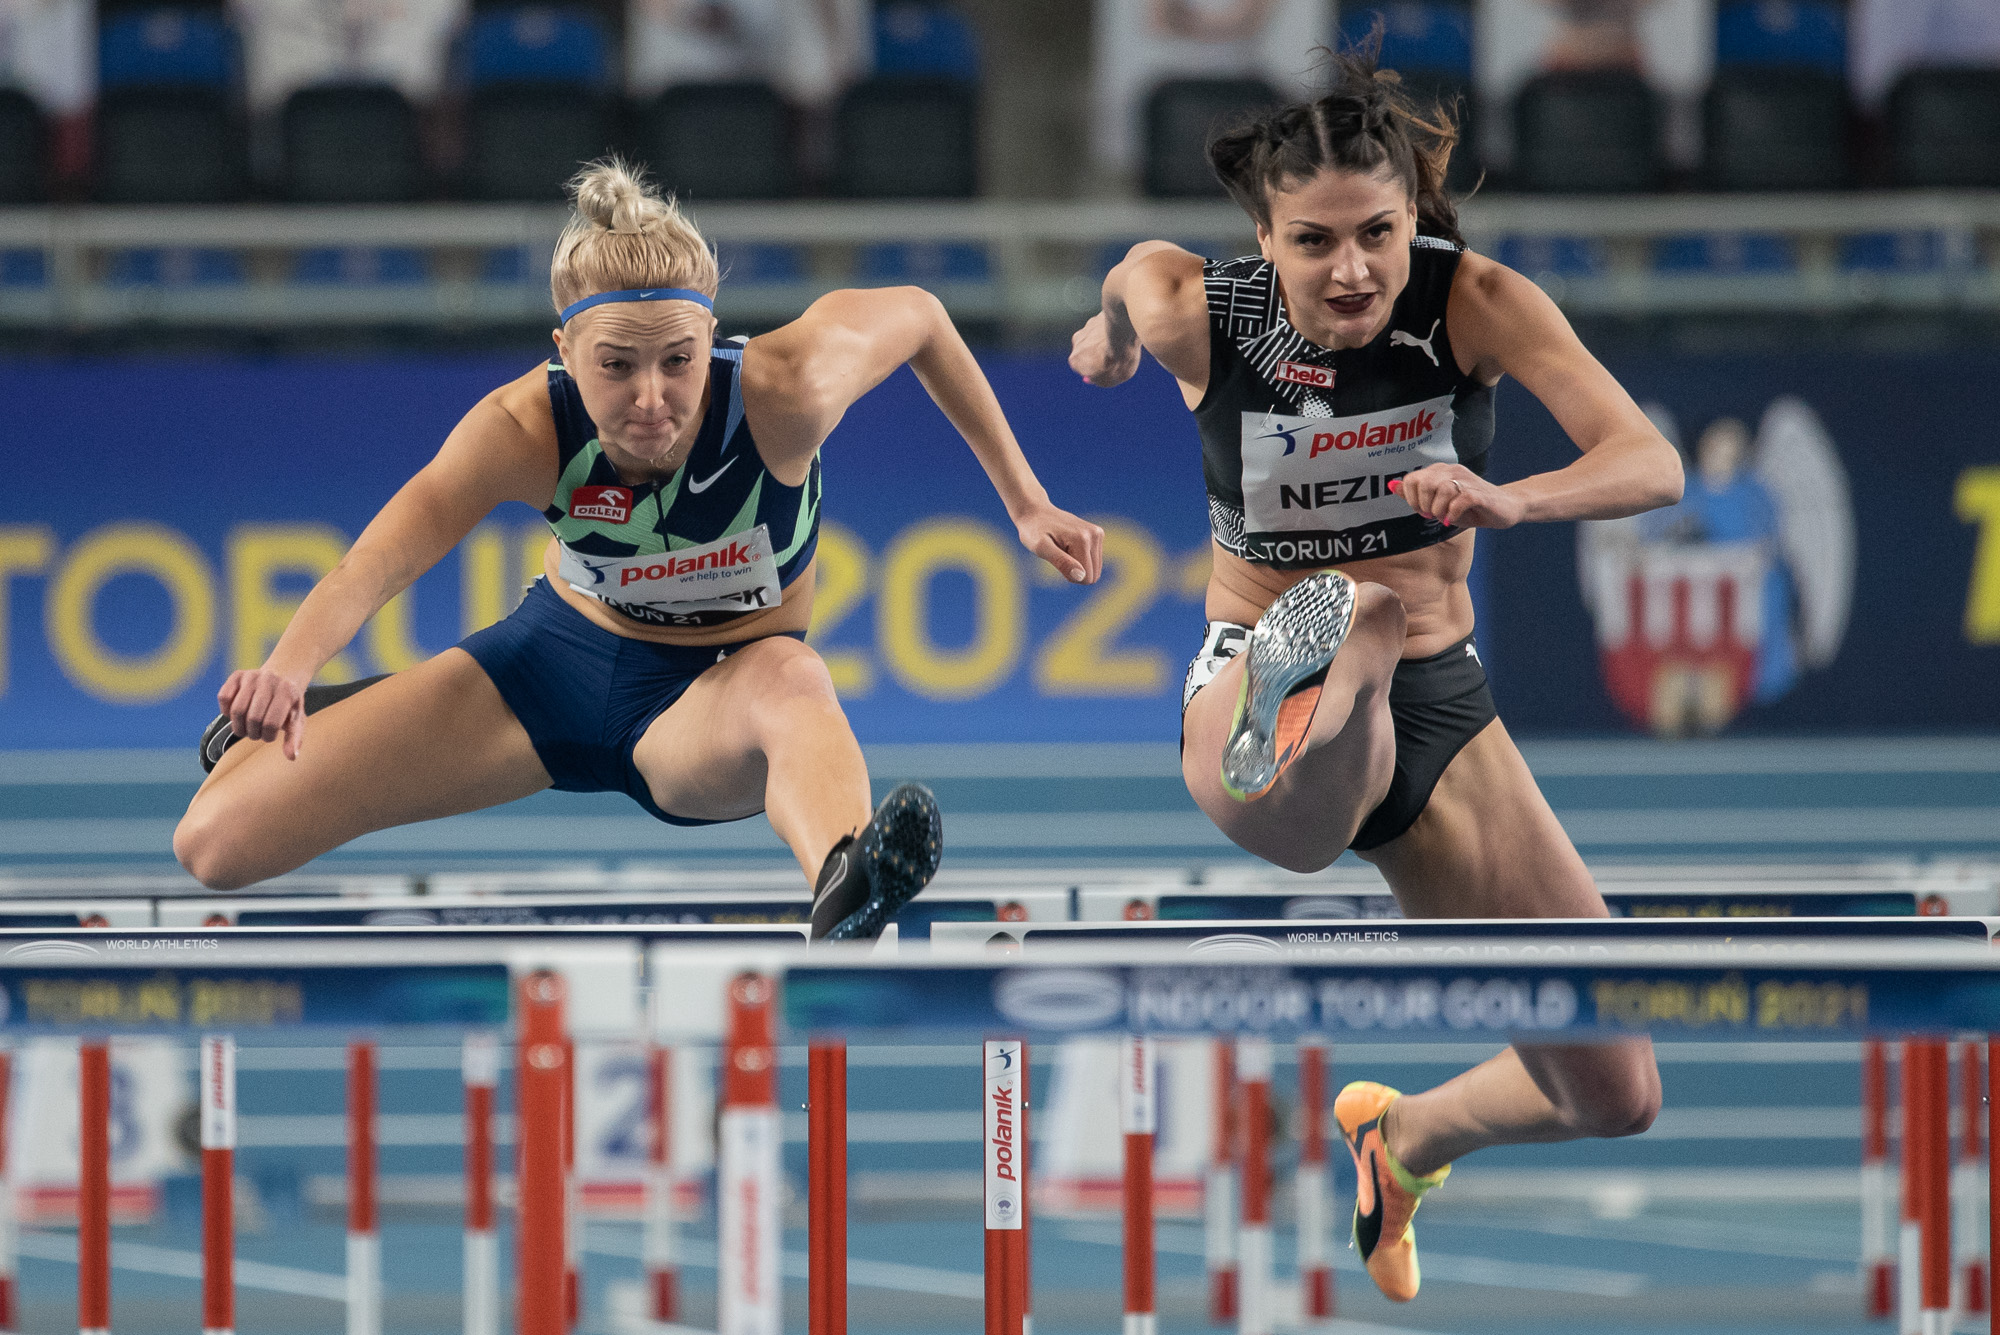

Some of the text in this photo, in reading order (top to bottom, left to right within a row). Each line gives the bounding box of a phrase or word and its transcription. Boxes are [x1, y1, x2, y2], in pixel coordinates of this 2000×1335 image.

[1286, 365, 1327, 384] helo
[1309, 408, 1437, 459] polanik
[1367, 450, 1382, 458] we
[1384, 445, 1405, 455] help
[1408, 443, 1416, 451] to
[578, 507, 622, 517] ORLEN
[1260, 530, 1388, 562] TORUŃ 21
[620, 541, 750, 587] polanik
[680, 566, 752, 583] we help to win
[106, 939, 218, 950] WORLD ATHLETICS
[1287, 932, 1399, 943] WORLD ATHLETICS
[991, 1085, 1017, 1182] polanik
